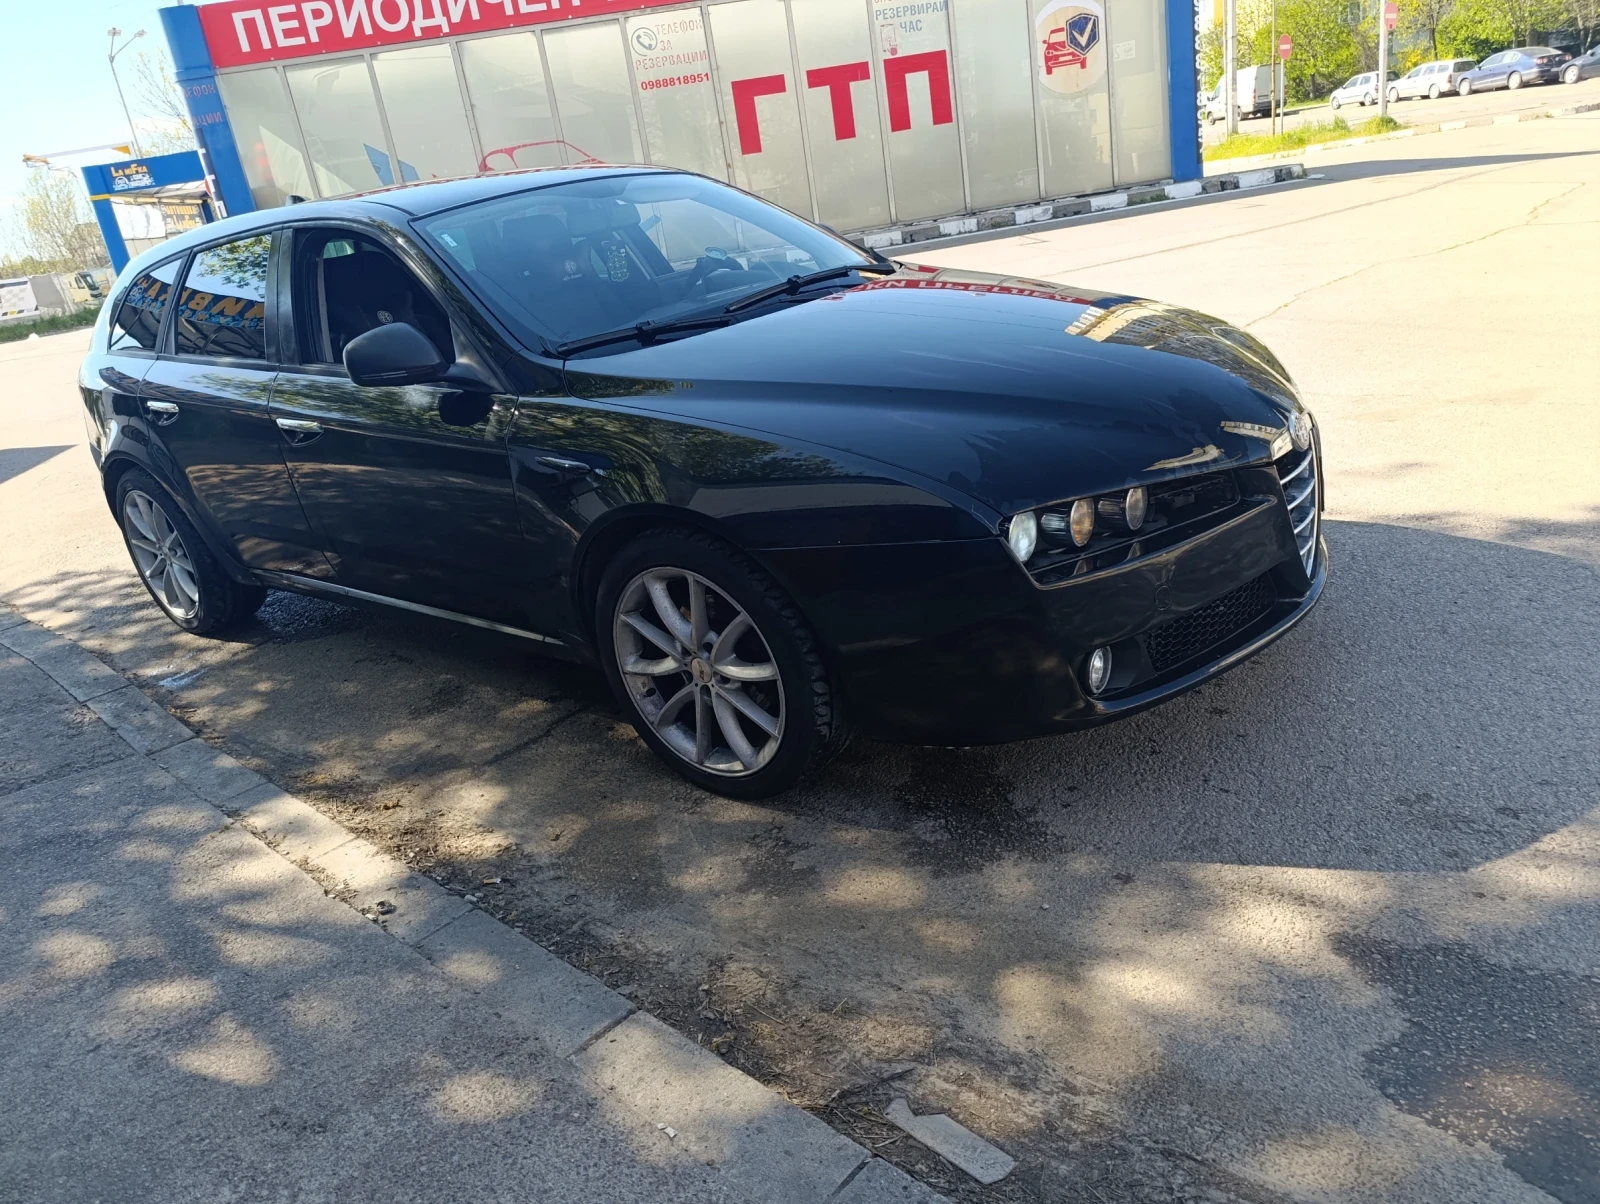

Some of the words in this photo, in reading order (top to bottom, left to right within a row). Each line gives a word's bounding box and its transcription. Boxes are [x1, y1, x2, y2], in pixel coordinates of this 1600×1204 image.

[232, 0, 580, 52] ПЕРИОДИ
[655, 19, 702, 36] ТЕЛЕФОН
[899, 19, 923, 33] ЧАС
[659, 39, 673, 51] ЗА
[635, 50, 707, 71] РЕЗЕРВАЦИИ
[641, 72, 710, 91] 0988818951
[731, 49, 953, 155] ГТП
